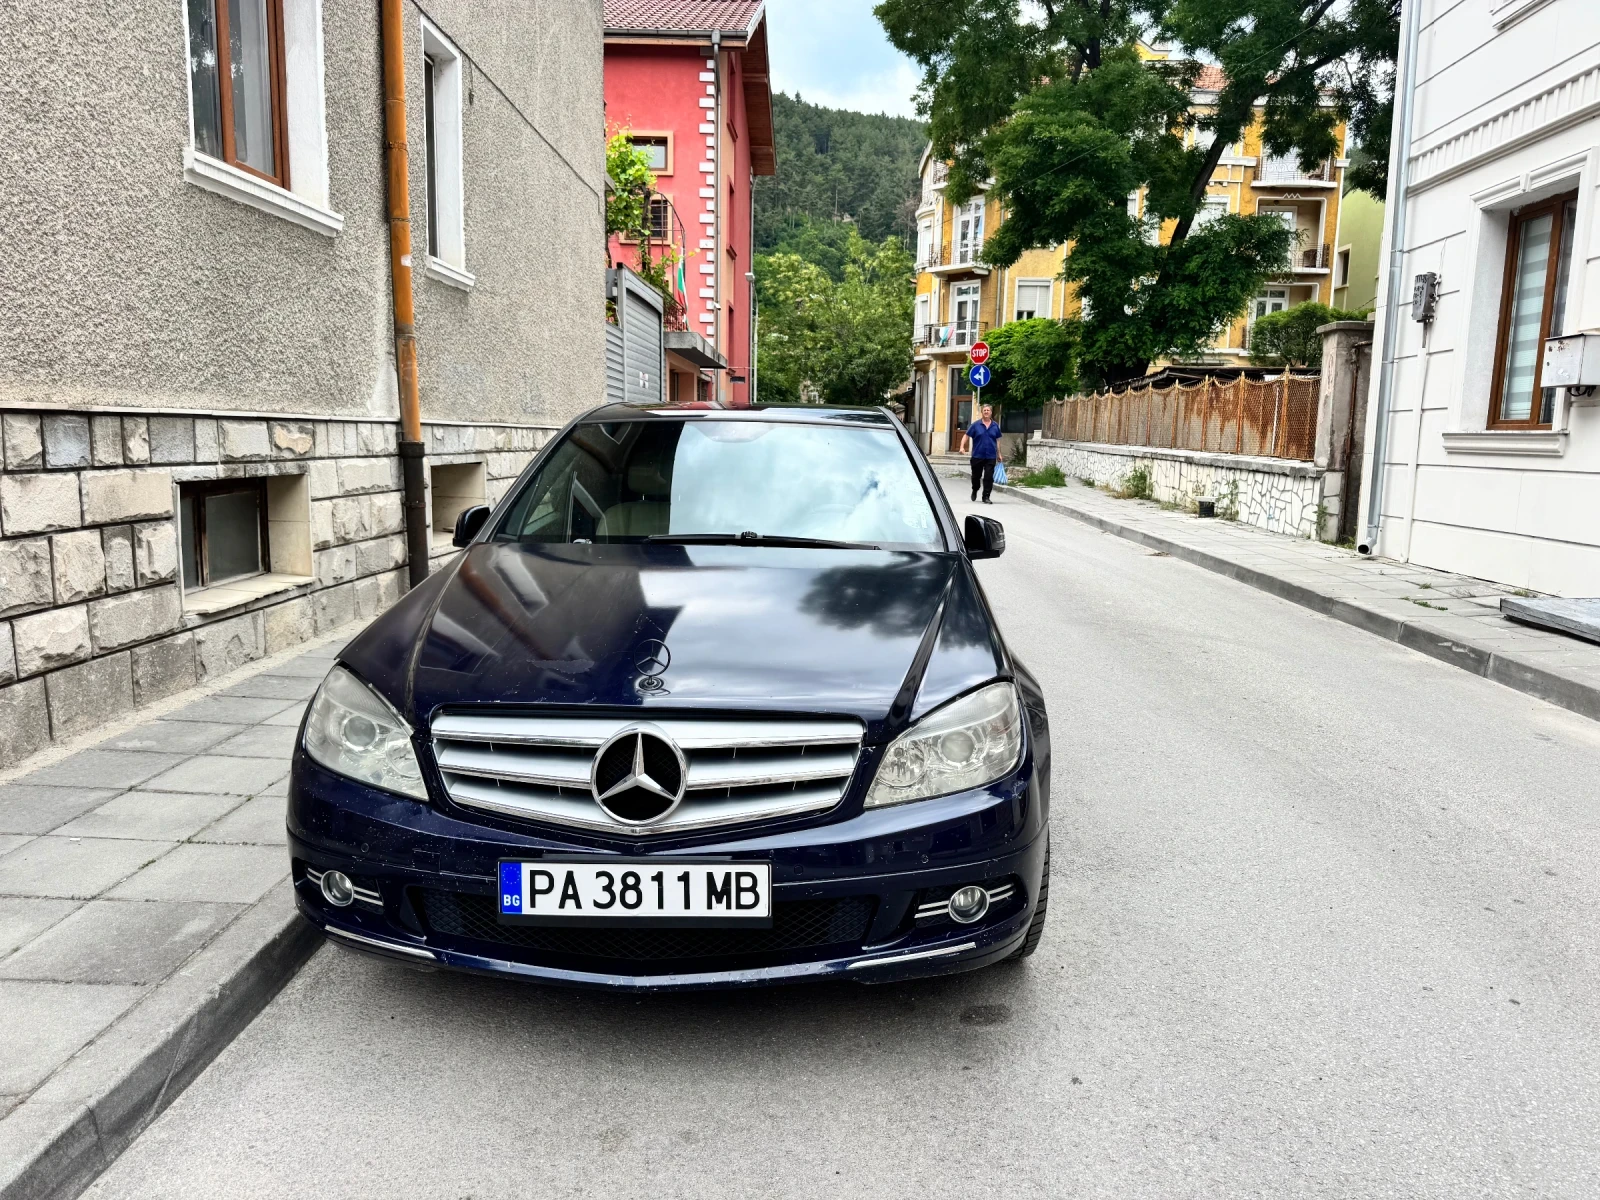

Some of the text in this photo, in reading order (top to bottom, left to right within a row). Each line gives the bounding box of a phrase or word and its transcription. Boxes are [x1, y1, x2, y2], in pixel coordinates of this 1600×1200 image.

[972, 348, 987, 357] STOP
[529, 869, 760, 910] PA 3811 MB
[503, 894, 520, 906] BG
